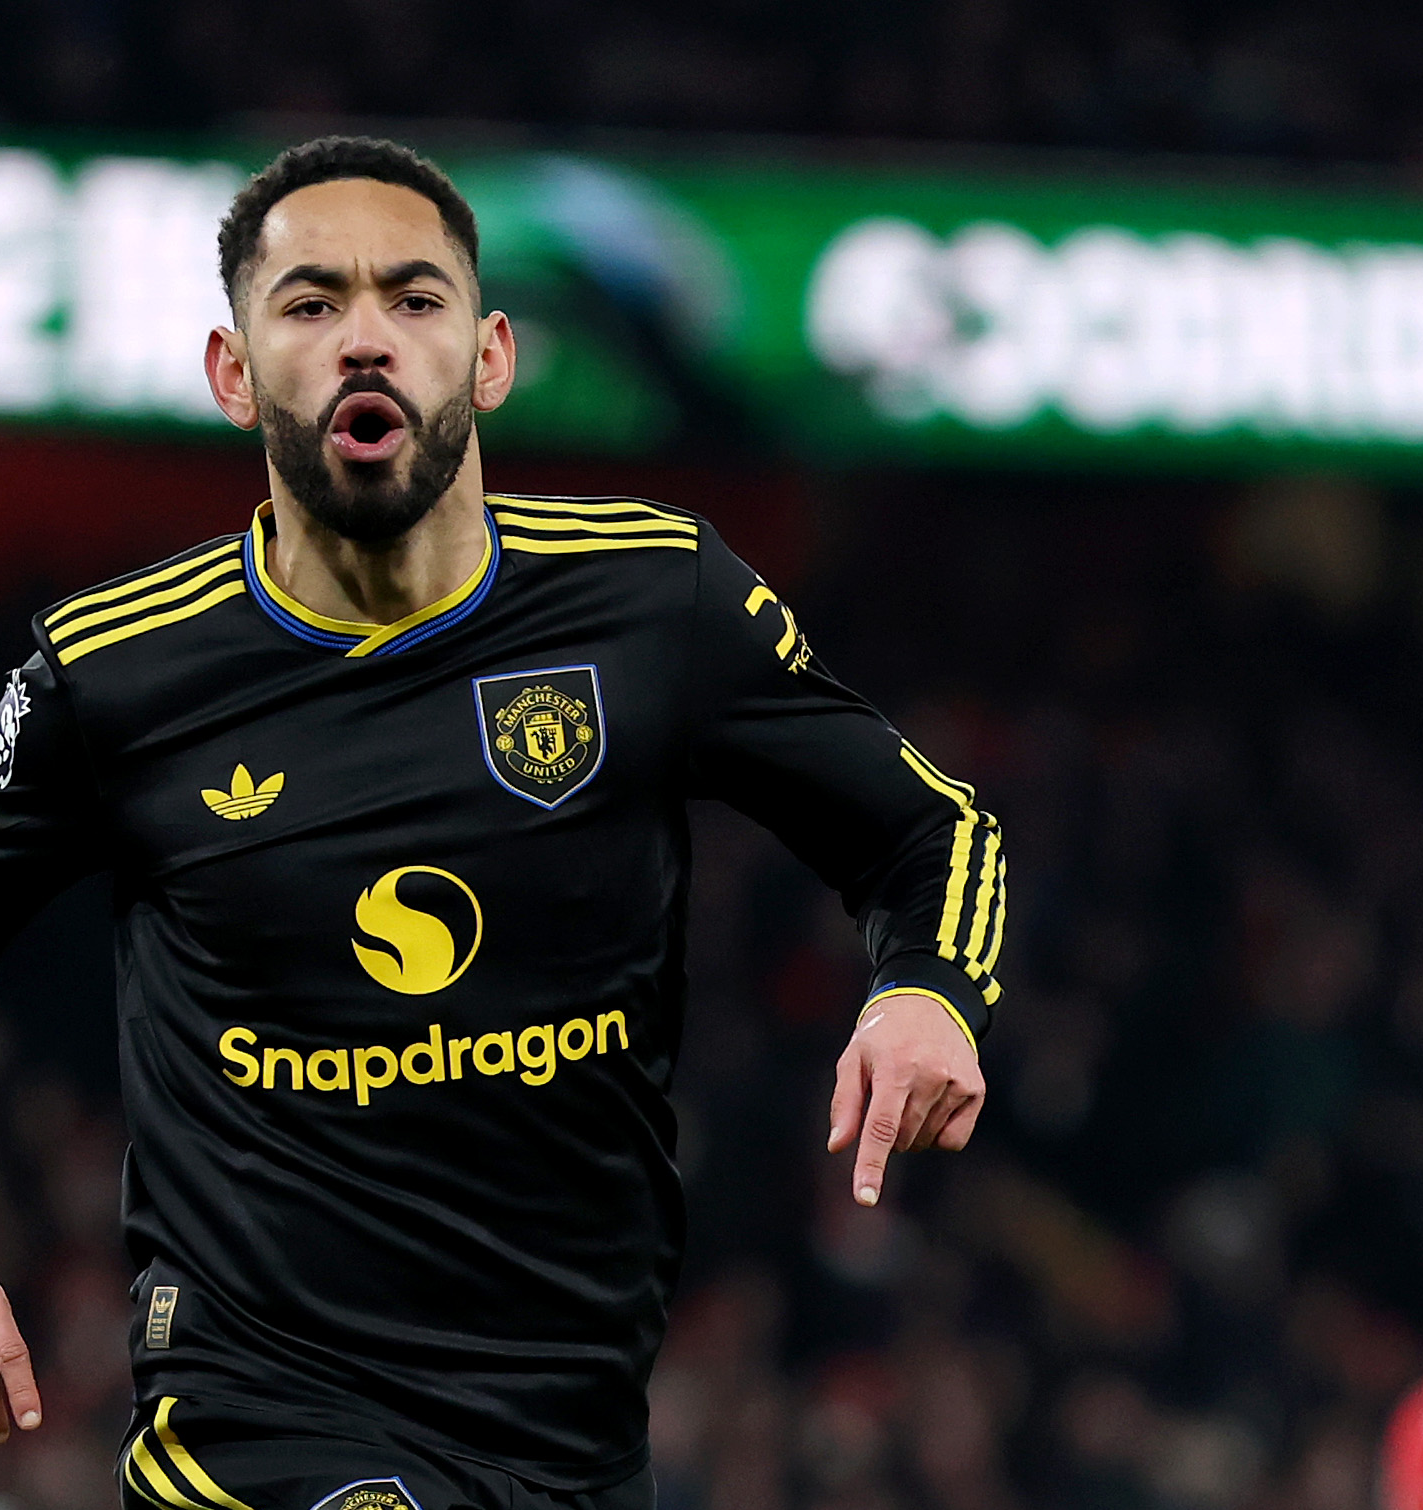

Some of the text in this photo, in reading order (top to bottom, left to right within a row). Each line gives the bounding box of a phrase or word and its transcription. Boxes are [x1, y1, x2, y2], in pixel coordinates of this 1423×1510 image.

[503, 693, 580, 728] MANCHESTER
[523, 757, 576, 777] UNITED
[218, 1009, 629, 1106] Snapdragon
